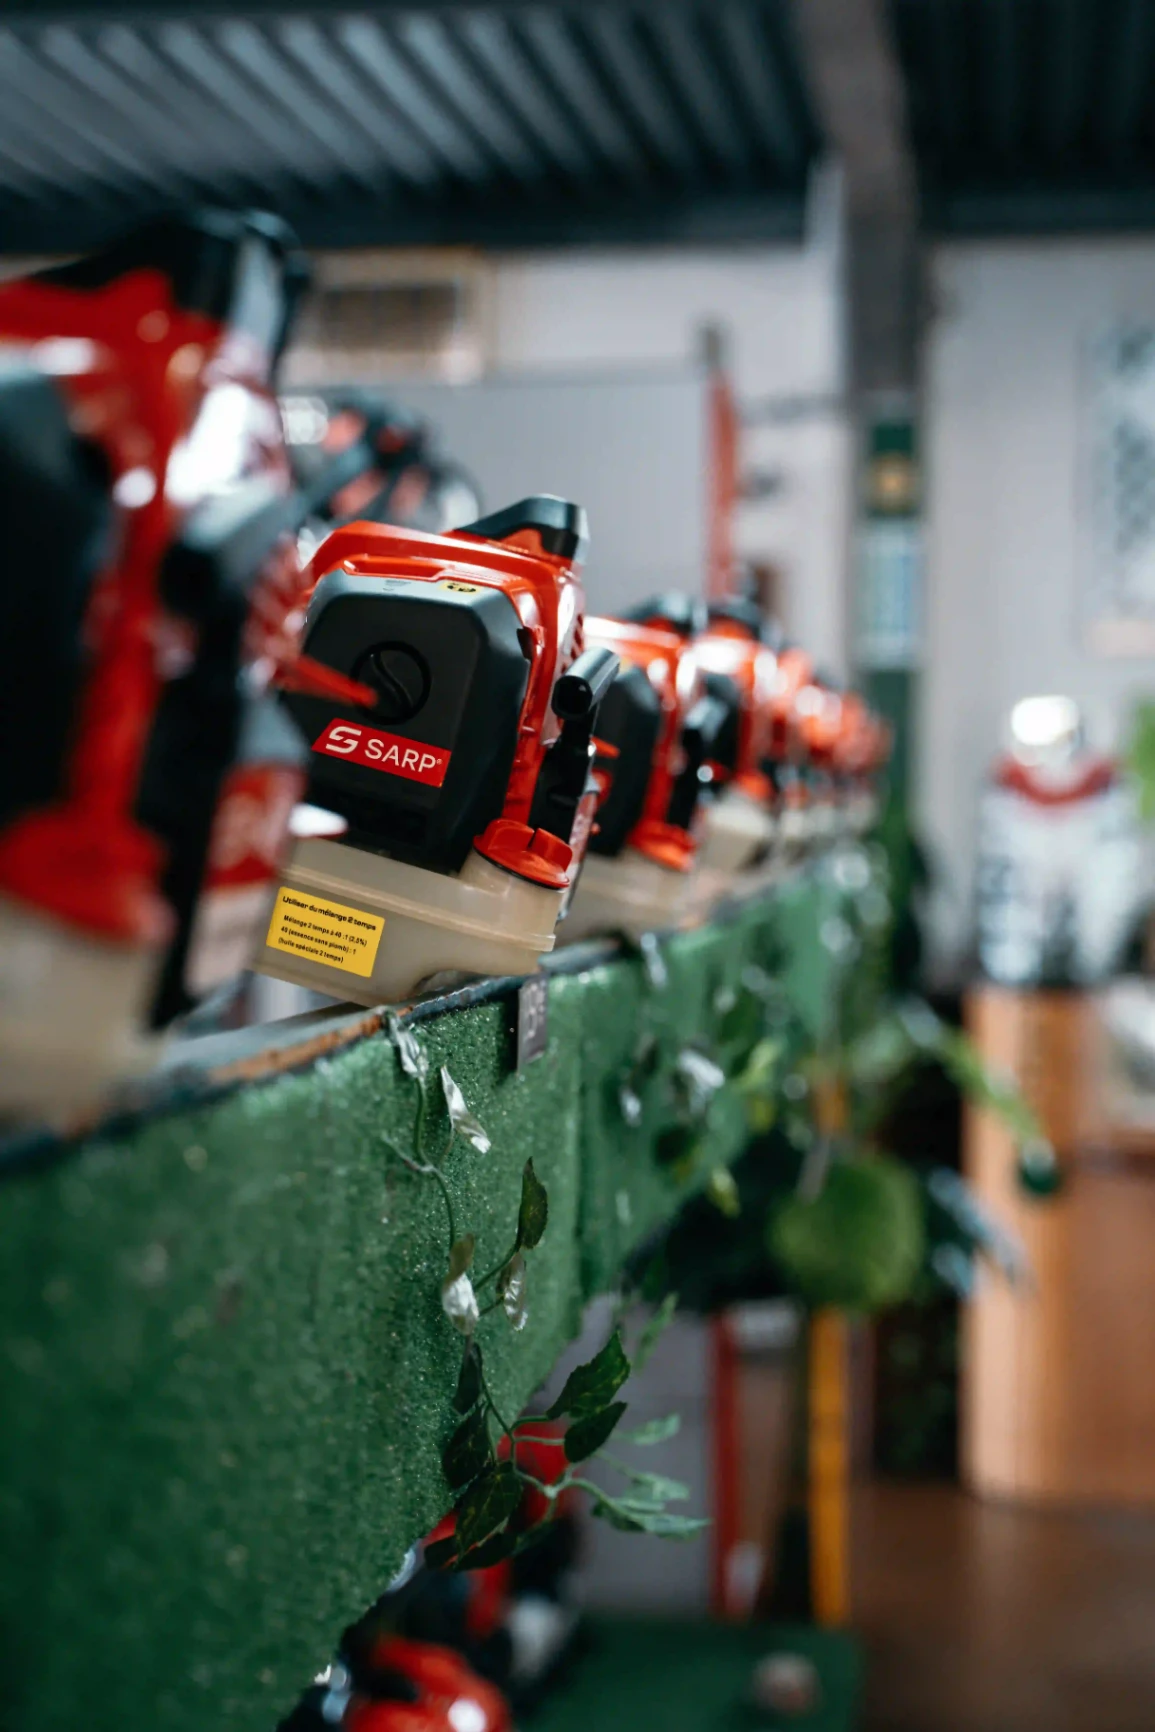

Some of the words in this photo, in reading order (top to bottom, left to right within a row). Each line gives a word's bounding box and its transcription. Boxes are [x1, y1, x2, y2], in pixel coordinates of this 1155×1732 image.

[283, 896, 308, 909] Utiliser
[309, 903, 317, 912] du
[318, 907, 346, 922] mélange
[353, 919, 376, 930] temps
[284, 915, 307, 928] Mélange
[312, 924, 330, 935] temps
[288, 929, 314, 941] (essence
[315, 937, 328, 946] sans
[328, 942, 349, 953] plomb)
[296, 942, 318, 954] spéciale
[324, 951, 343, 963] temps)
